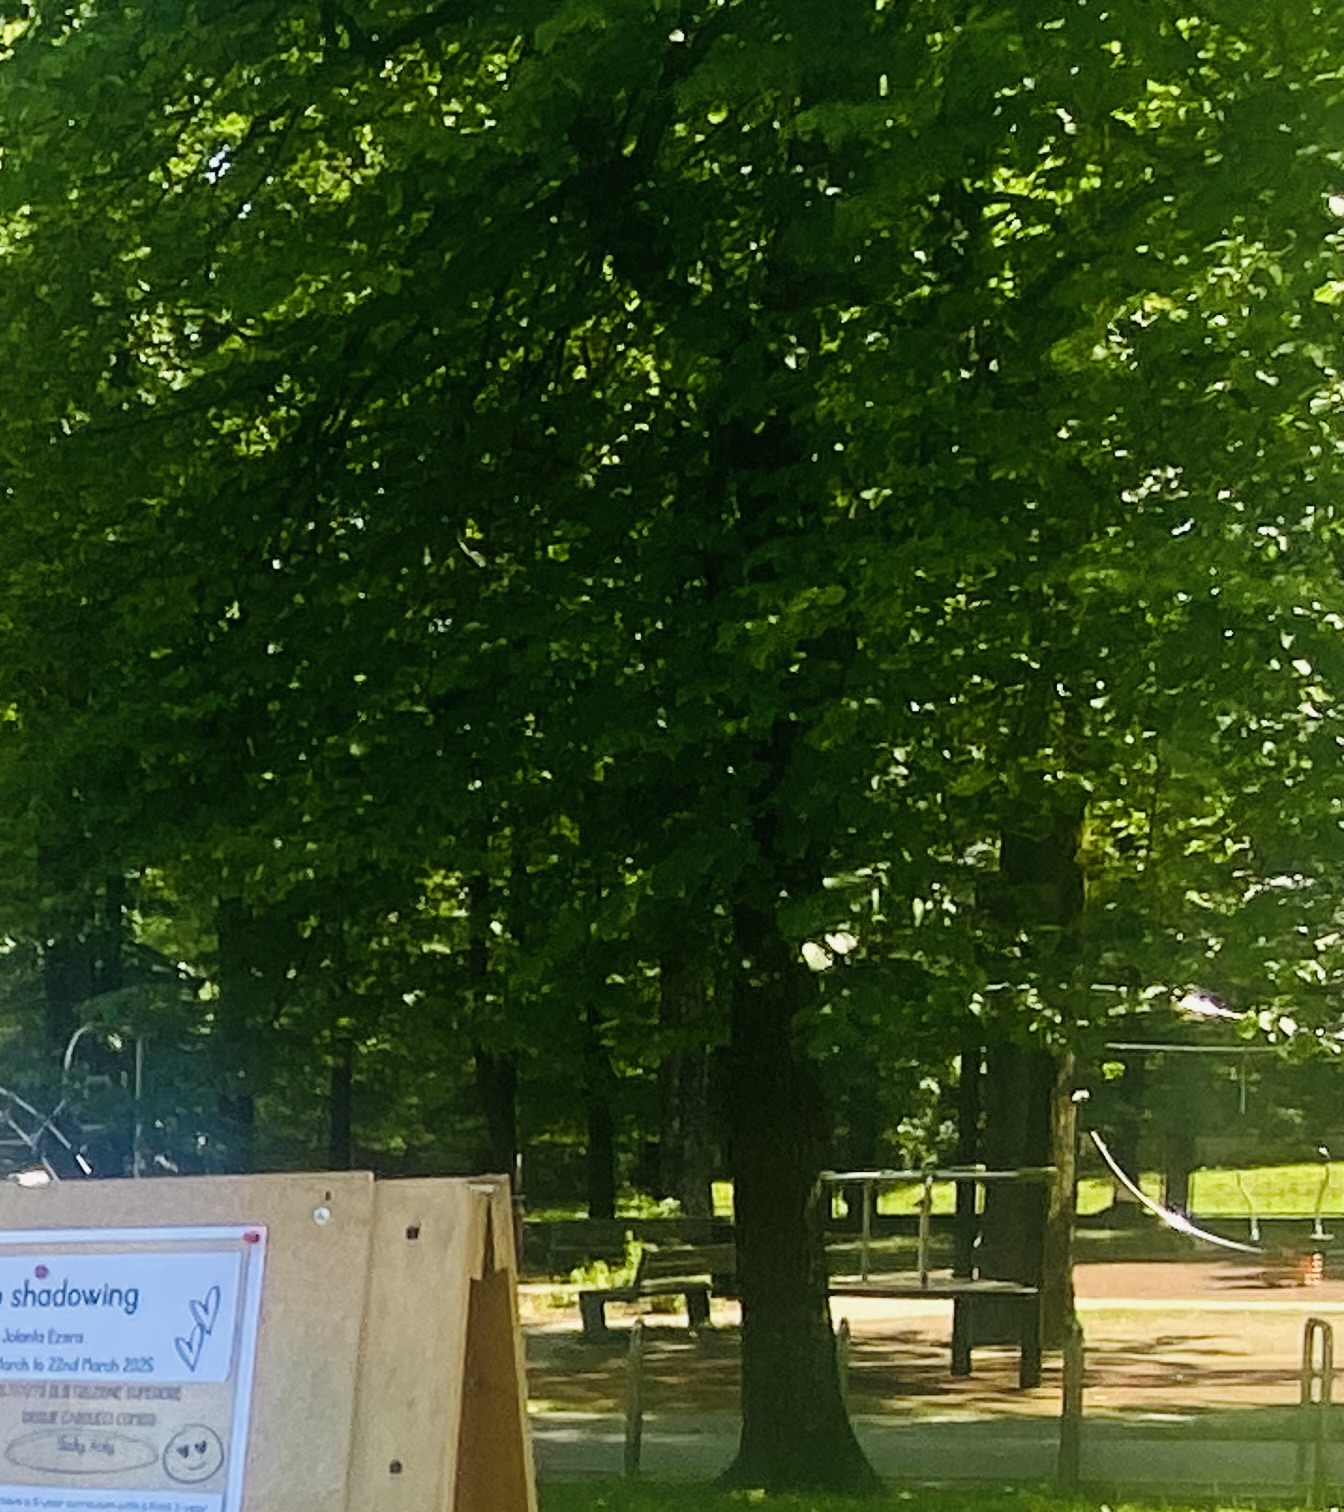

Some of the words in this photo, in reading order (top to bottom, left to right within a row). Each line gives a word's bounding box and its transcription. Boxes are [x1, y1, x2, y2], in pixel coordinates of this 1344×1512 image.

[11, 1279, 139, 1315] shadowing
[33, 1356, 45, 1372] to
[82, 1356, 120, 1373] March
